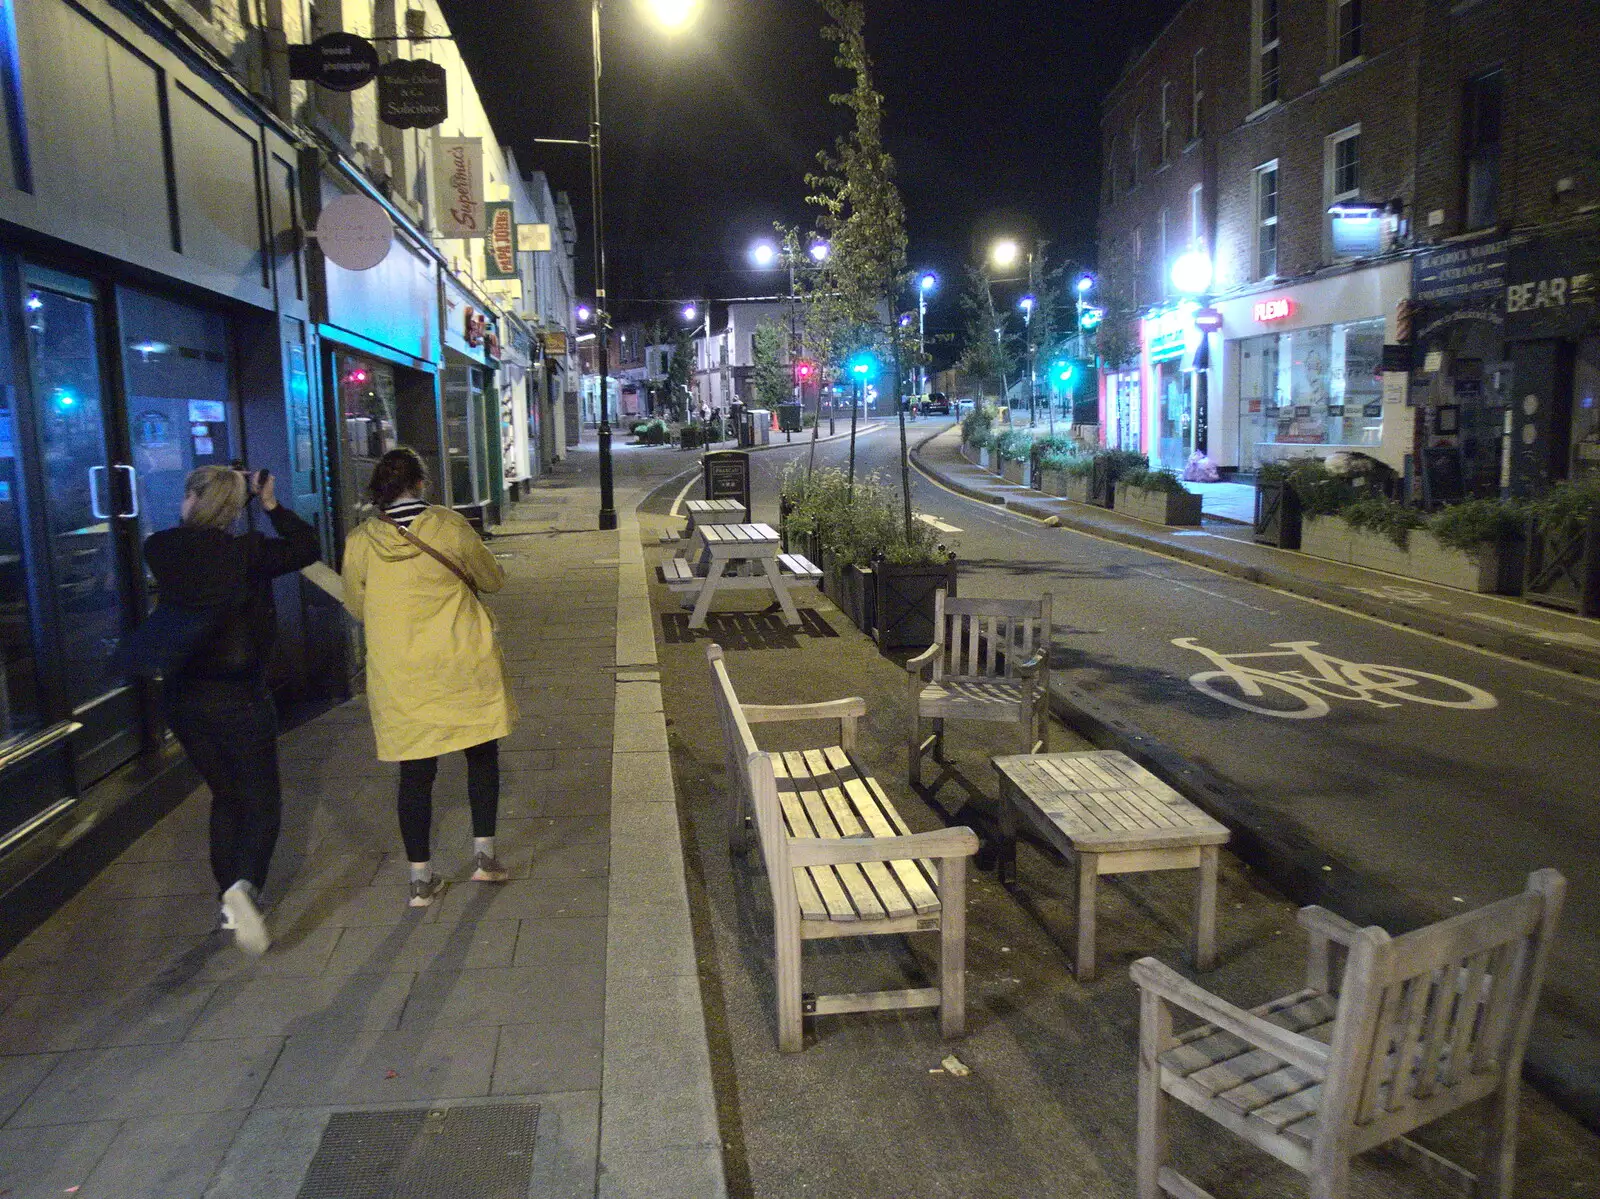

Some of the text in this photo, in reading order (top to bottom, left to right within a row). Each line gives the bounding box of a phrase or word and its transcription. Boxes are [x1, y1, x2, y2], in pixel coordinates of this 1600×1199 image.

[448, 145, 477, 230] Supermac's
[495, 244, 513, 272] PAPA
[1507, 277, 1567, 313] BEAR
